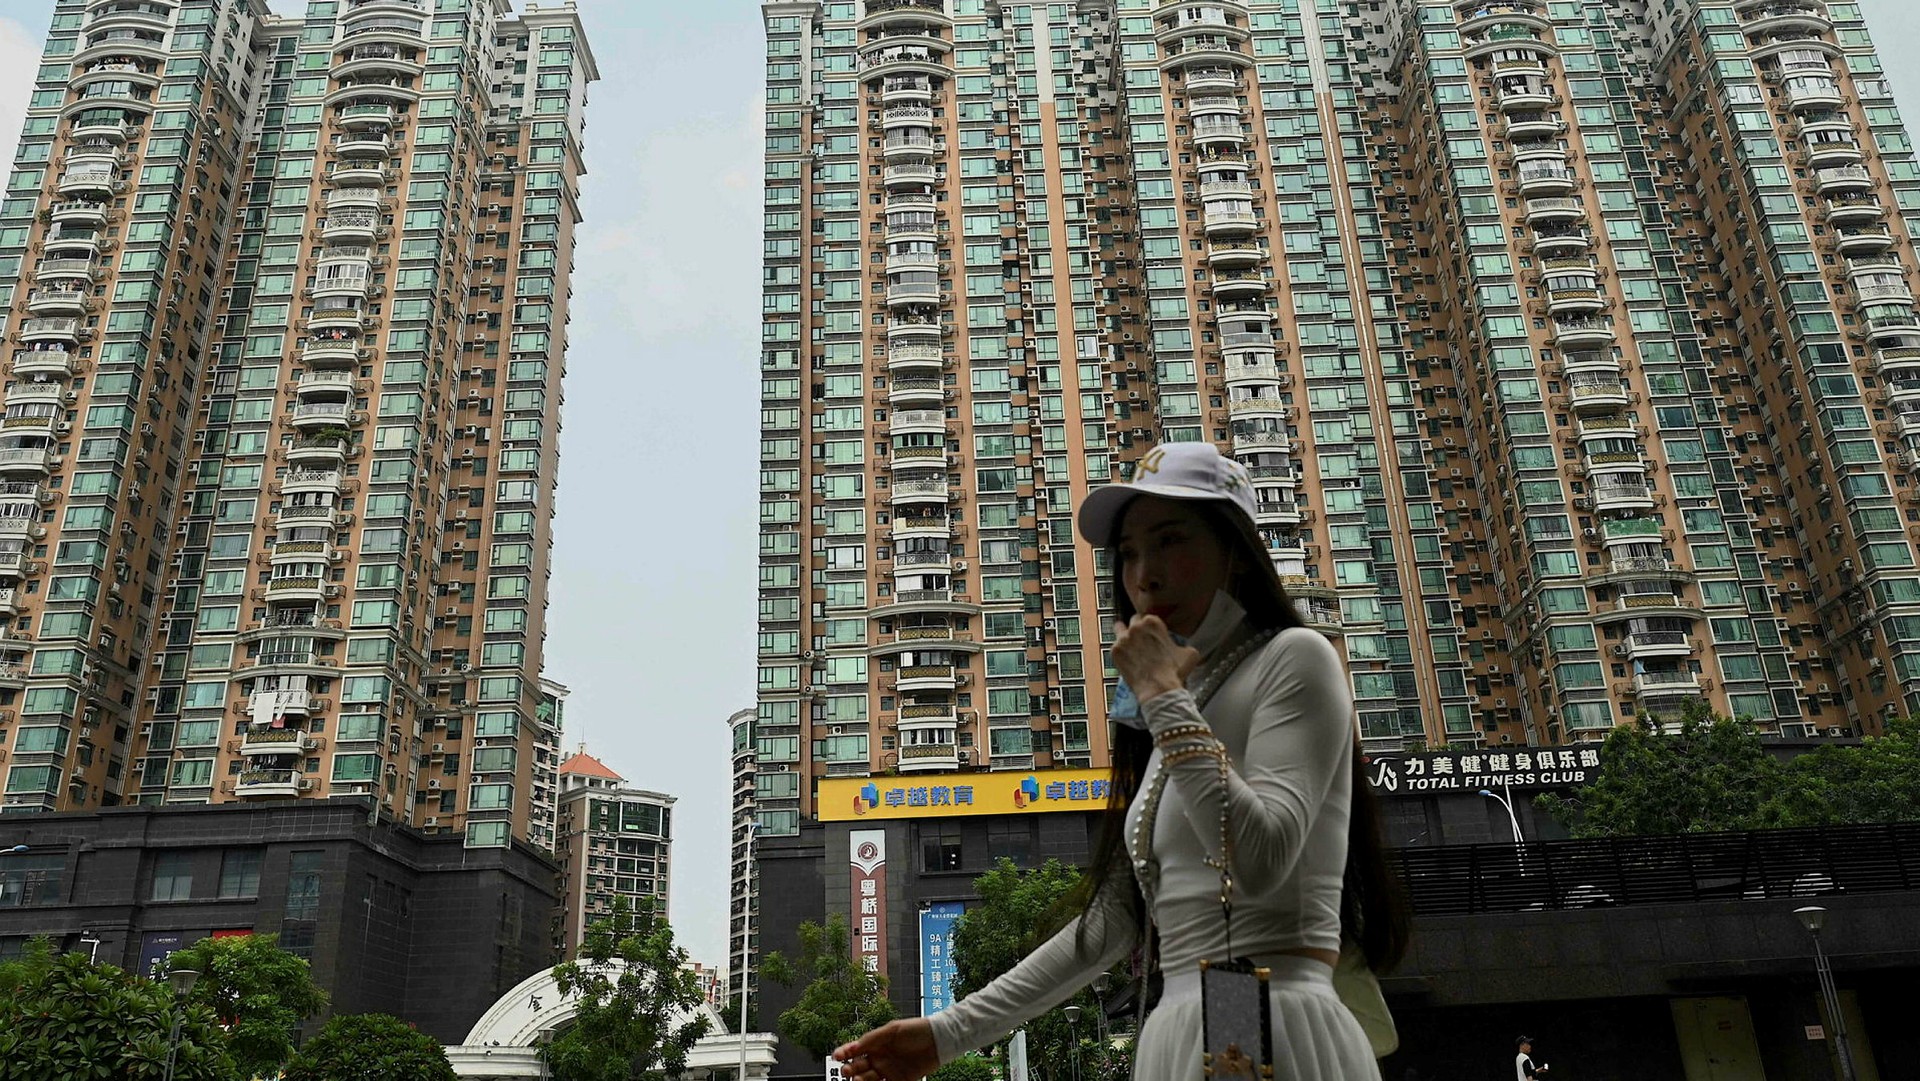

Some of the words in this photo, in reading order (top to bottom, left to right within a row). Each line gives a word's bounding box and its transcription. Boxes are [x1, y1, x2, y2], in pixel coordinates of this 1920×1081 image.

[1046, 779, 1111, 801] 卓越教
[1406, 777, 1460, 790] TOTAL
[1464, 773, 1536, 787] FITNESS
[1540, 771, 1585, 784] CLUB
[885, 785, 974, 807] 卓越教育
[860, 879, 879, 990] 粤桥国际旅
